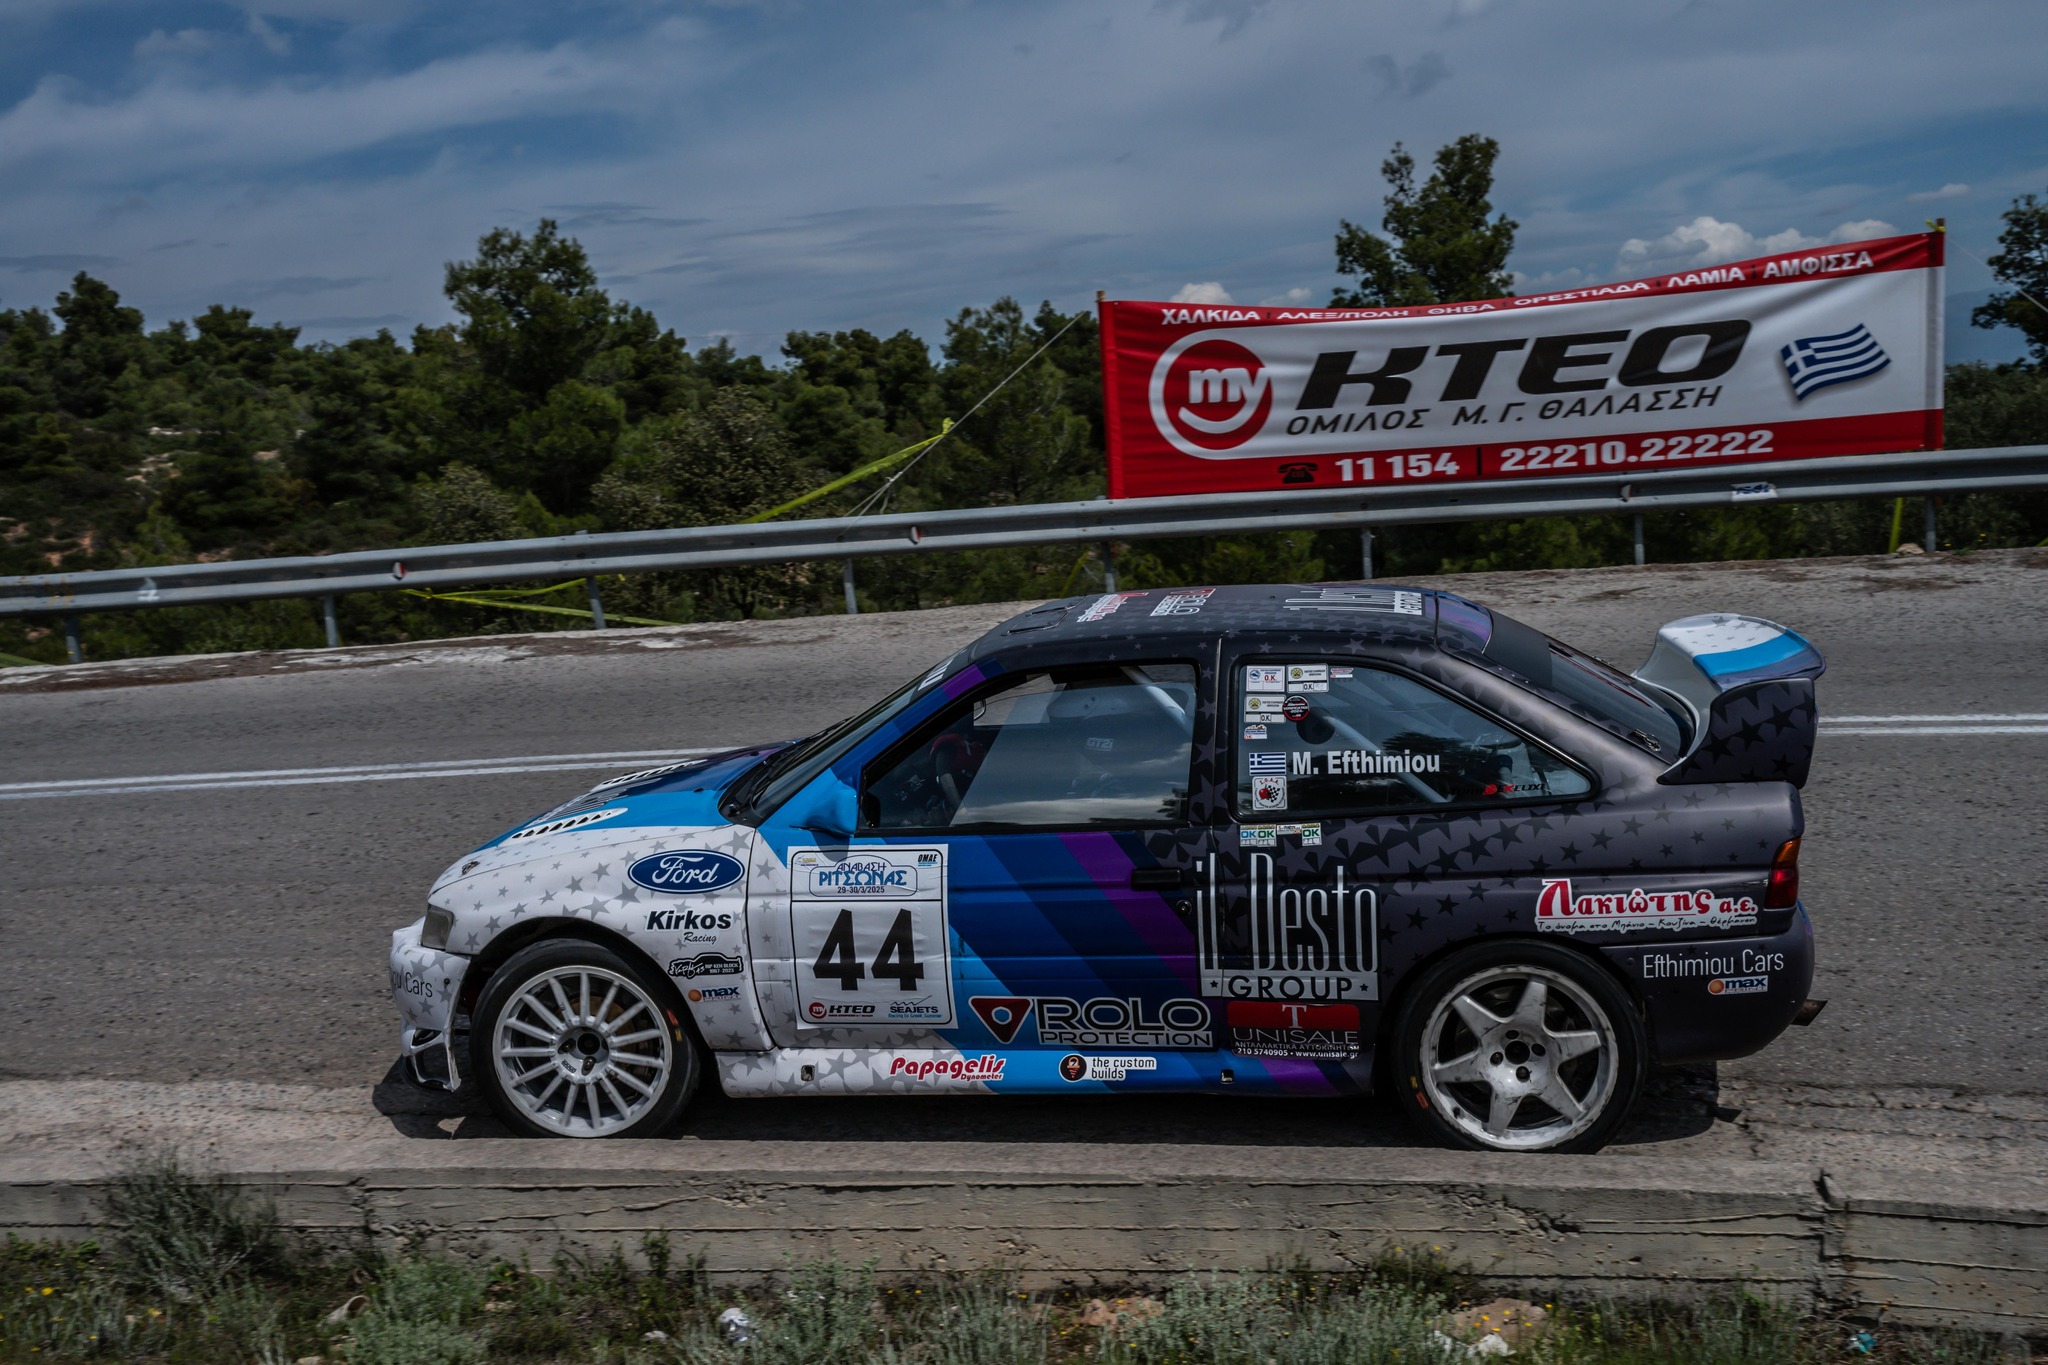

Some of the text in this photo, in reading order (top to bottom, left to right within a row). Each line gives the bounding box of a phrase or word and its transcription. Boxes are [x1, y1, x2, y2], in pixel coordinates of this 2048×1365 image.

[1161, 251, 1875, 325] ΧΑΛΚΙΔΑ ΑΛΕΞ/ΠΟΛΗ ΘΗΒΑ ΟΡΕΣΤΙΑΔΑ ΛΑΜΙΑ ΑΜΦΙΣΣΑ
[1188, 366, 1271, 404] my
[1286, 408, 1431, 437] ΟΜΙΛΟΣ
[1537, 385, 1724, 421] ΘΑΛΑΣΣΗ
[1335, 429, 1775, 482] 11 154 22210.22222
[1292, 749, 1441, 775] M. Efthimiou
[1258, 830, 1274, 838] OK
[1302, 829, 1320, 837] OK
[651, 856, 720, 885] Ford
[836, 861, 887, 872] ΑΝΑΒΑΣΗ
[819, 870, 907, 887] ΡΙΤΣΩΝΑΣ
[837, 886, 885, 894] 29-30/3/2025
[646, 910, 732, 930] Kirkos
[1538, 921, 1551, 930] Το
[683, 932, 717, 945] Racing
[812, 908, 925, 991] 44
[1643, 949, 1785, 979] Efthimiou Cars
[405, 971, 433, 998] Cars
[1228, 975, 1353, 999] GROUP
[1725, 977, 1767, 989] max
[702, 987, 740, 998] max
[890, 1006, 938, 1014] SEAJETS
[1036, 997, 1211, 1032] ROLO
[1040, 1031, 1211, 1046] PROTECTION
[1233, 1028, 1359, 1045] UNISALE
[1237, 1047, 1359, 1059] 210 5740905 www.unisale.gr
[890, 1055, 1005, 1080] Papagelis
[1092, 1057, 1155, 1068] the custom
[961, 1073, 1003, 1081] Dynometer
[1091, 1068, 1124, 1080] builds
